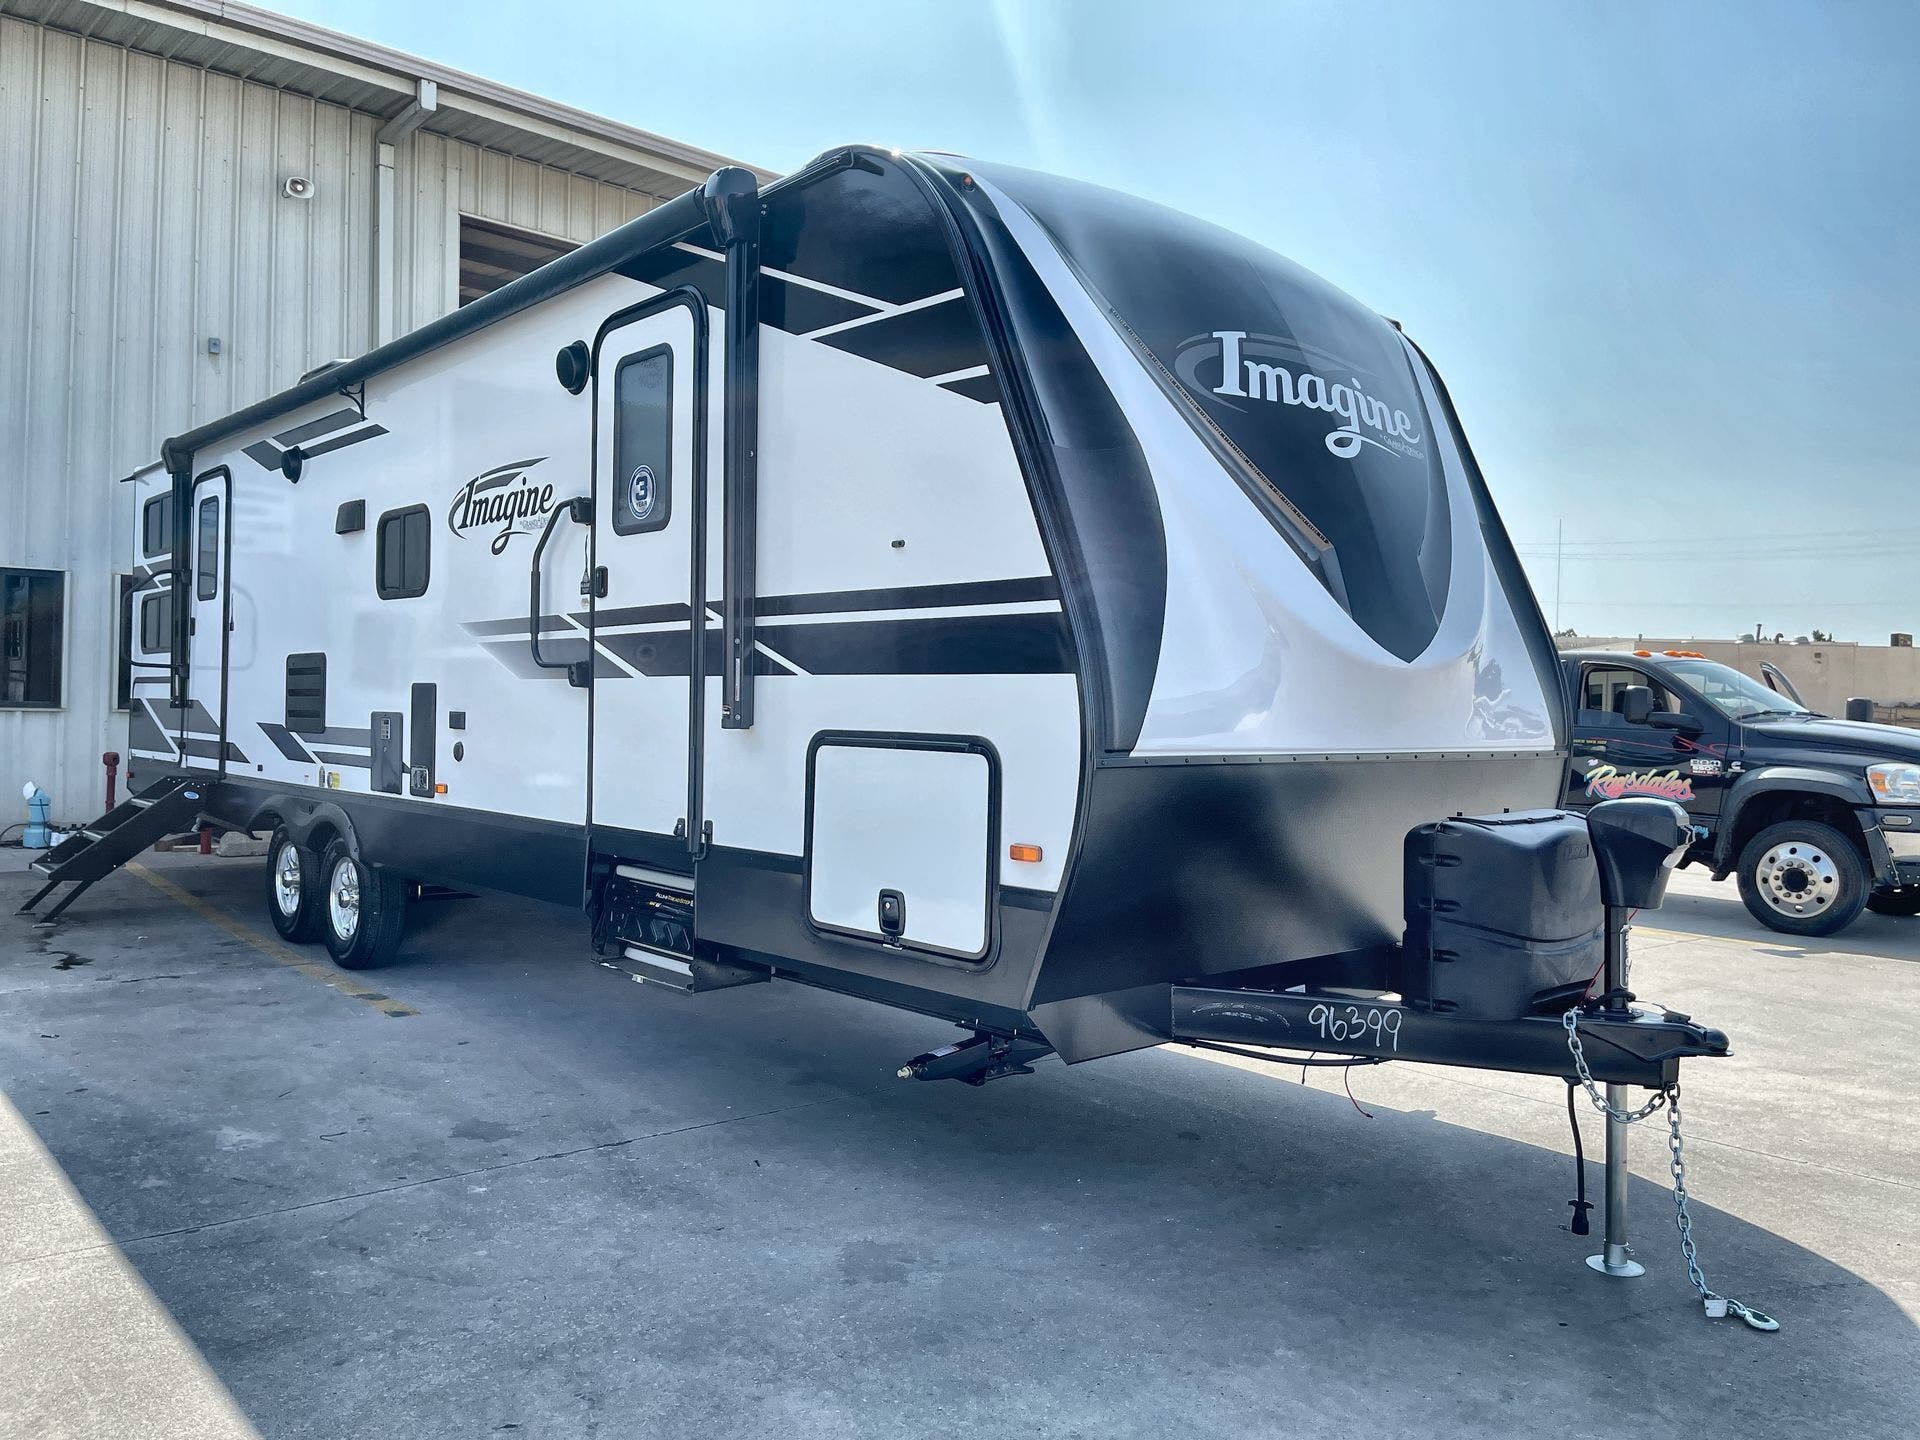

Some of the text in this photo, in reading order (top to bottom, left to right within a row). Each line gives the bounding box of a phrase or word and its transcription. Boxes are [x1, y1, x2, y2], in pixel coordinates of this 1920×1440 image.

[1212, 330, 1422, 459] Imagine
[457, 475, 558, 555] Imagine
[635, 475, 648, 501] 3
[1307, 1003, 1403, 1053] 96399
